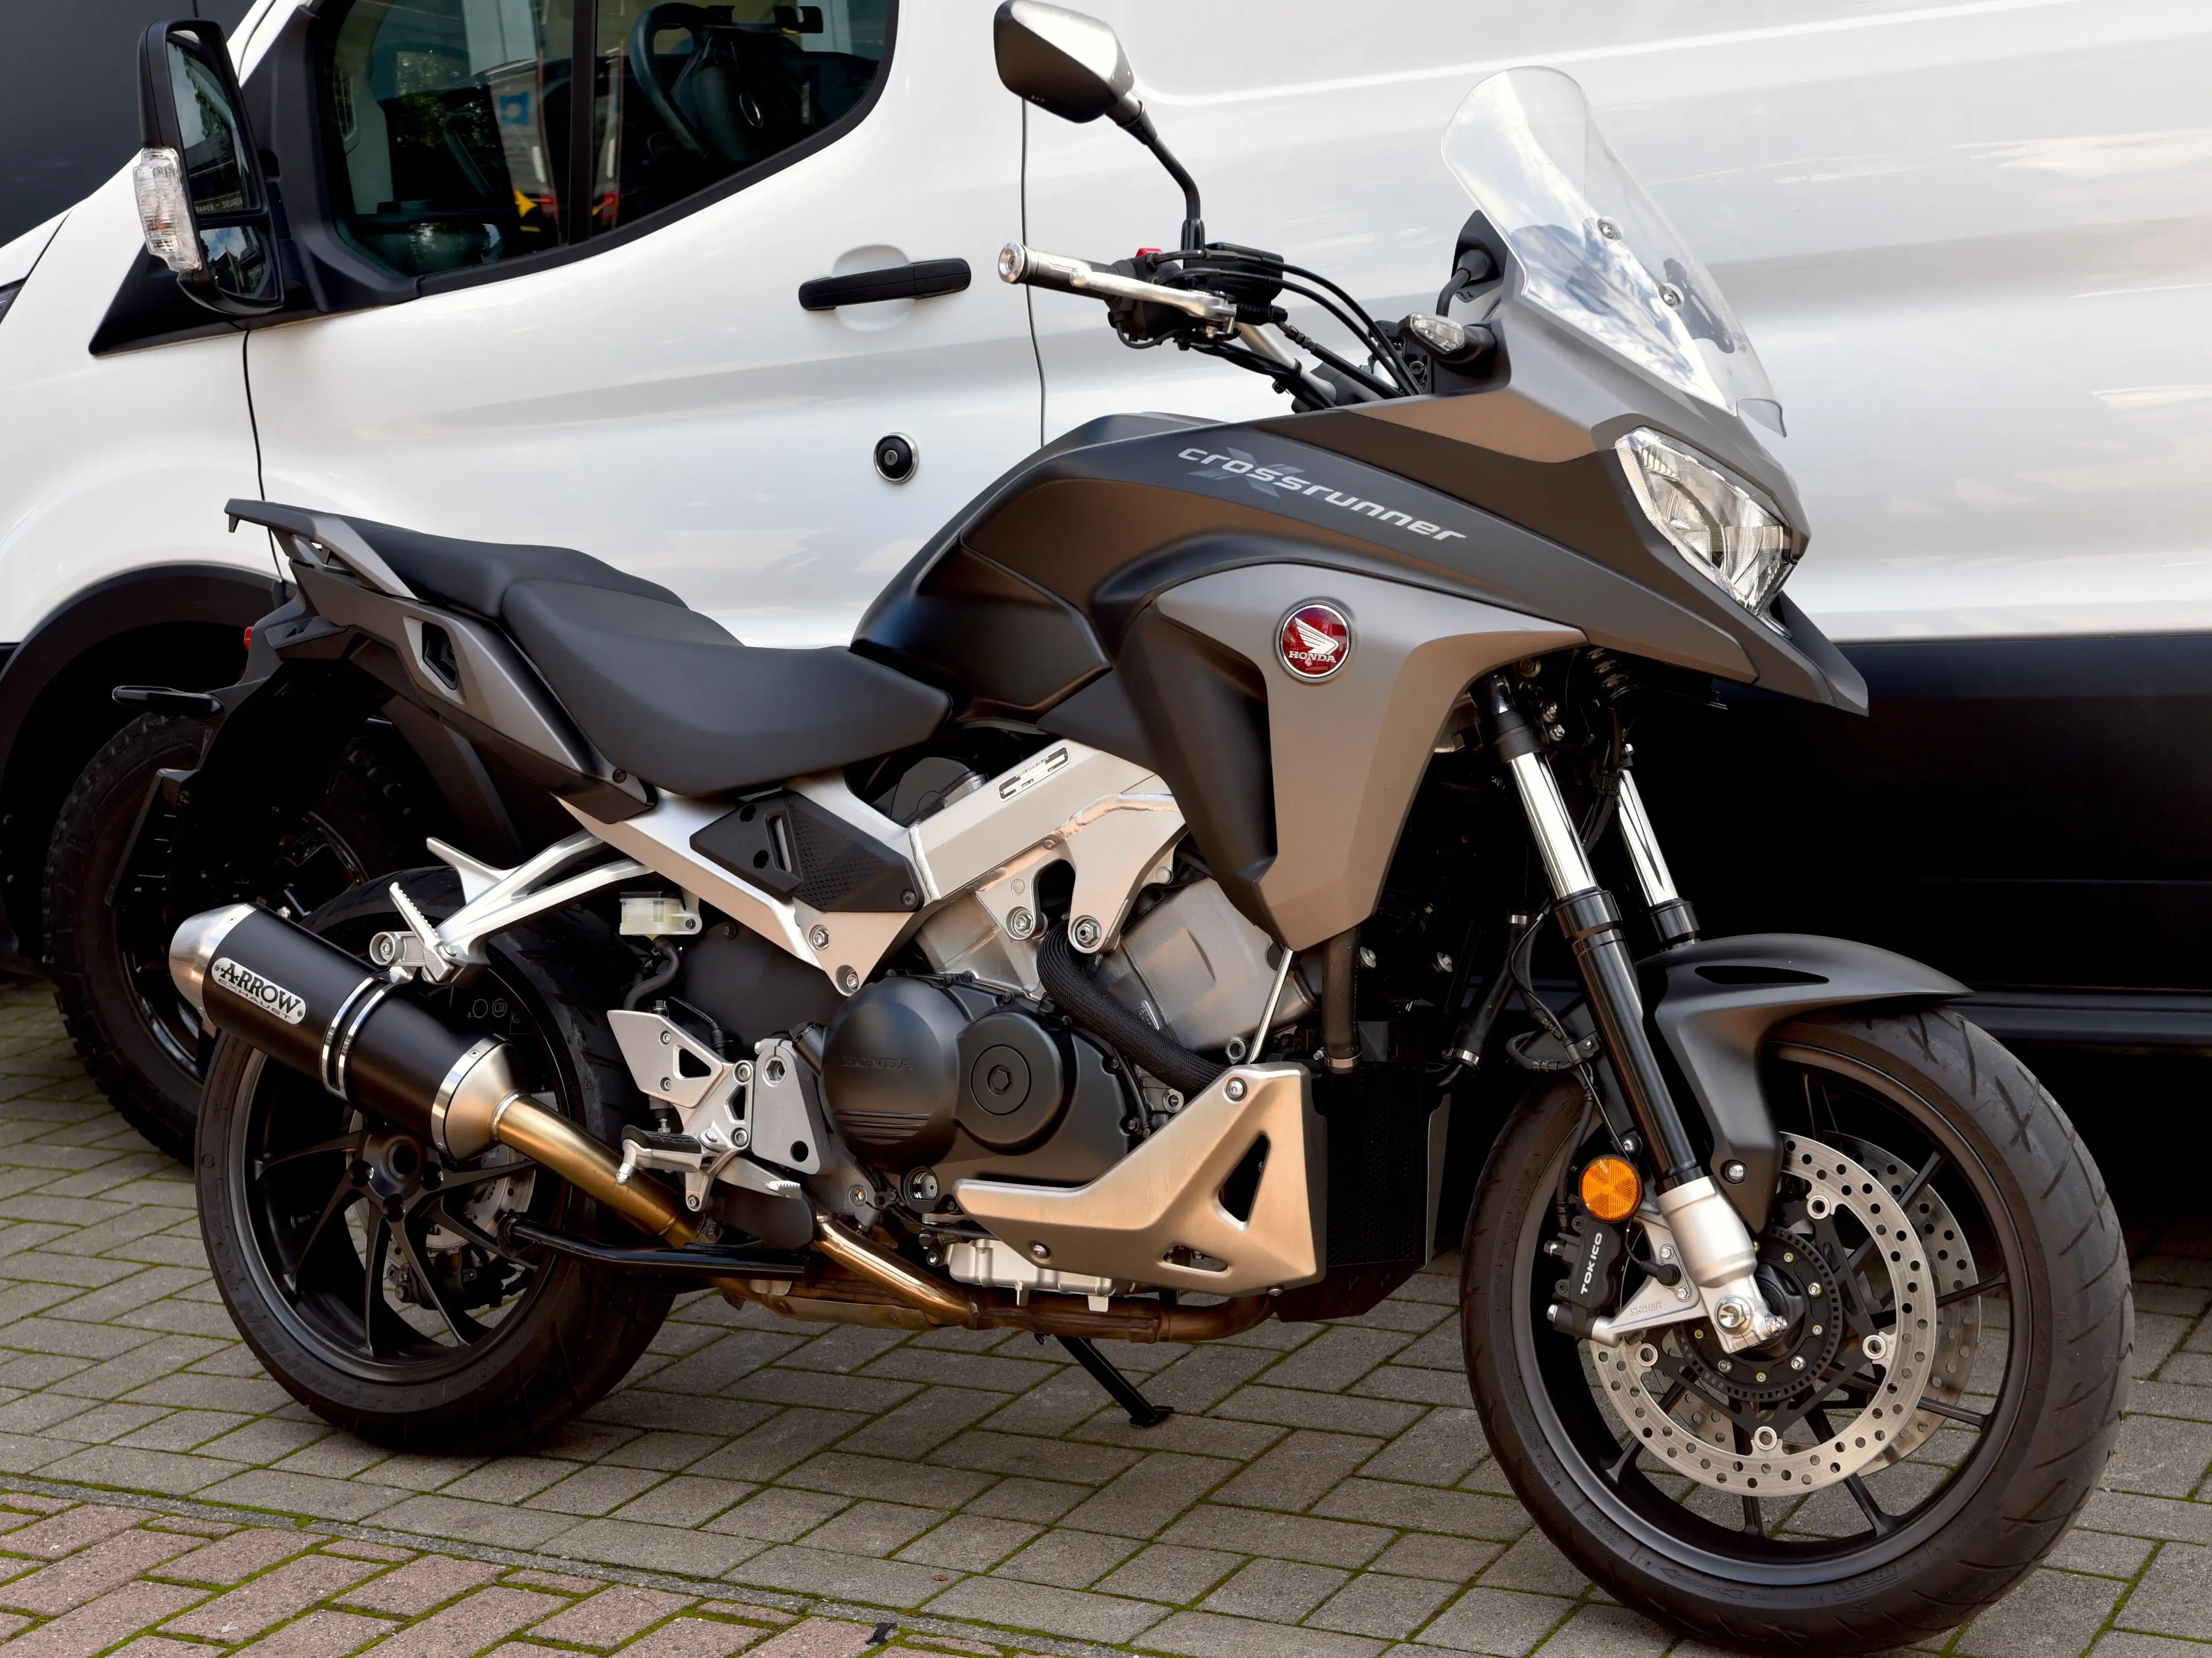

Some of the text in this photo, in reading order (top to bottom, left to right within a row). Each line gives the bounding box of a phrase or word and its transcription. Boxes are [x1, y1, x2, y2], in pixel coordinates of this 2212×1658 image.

[1177, 447, 1468, 542] crossrunner
[1288, 651, 1337, 663] HONDA
[218, 978, 292, 1019] EXHAUST
[221, 963, 301, 1014] ARROW
[841, 1055, 915, 1071] HONDA
[1580, 1232, 1603, 1295] TOKICO
[1630, 1300, 1664, 1316] SHOWA
